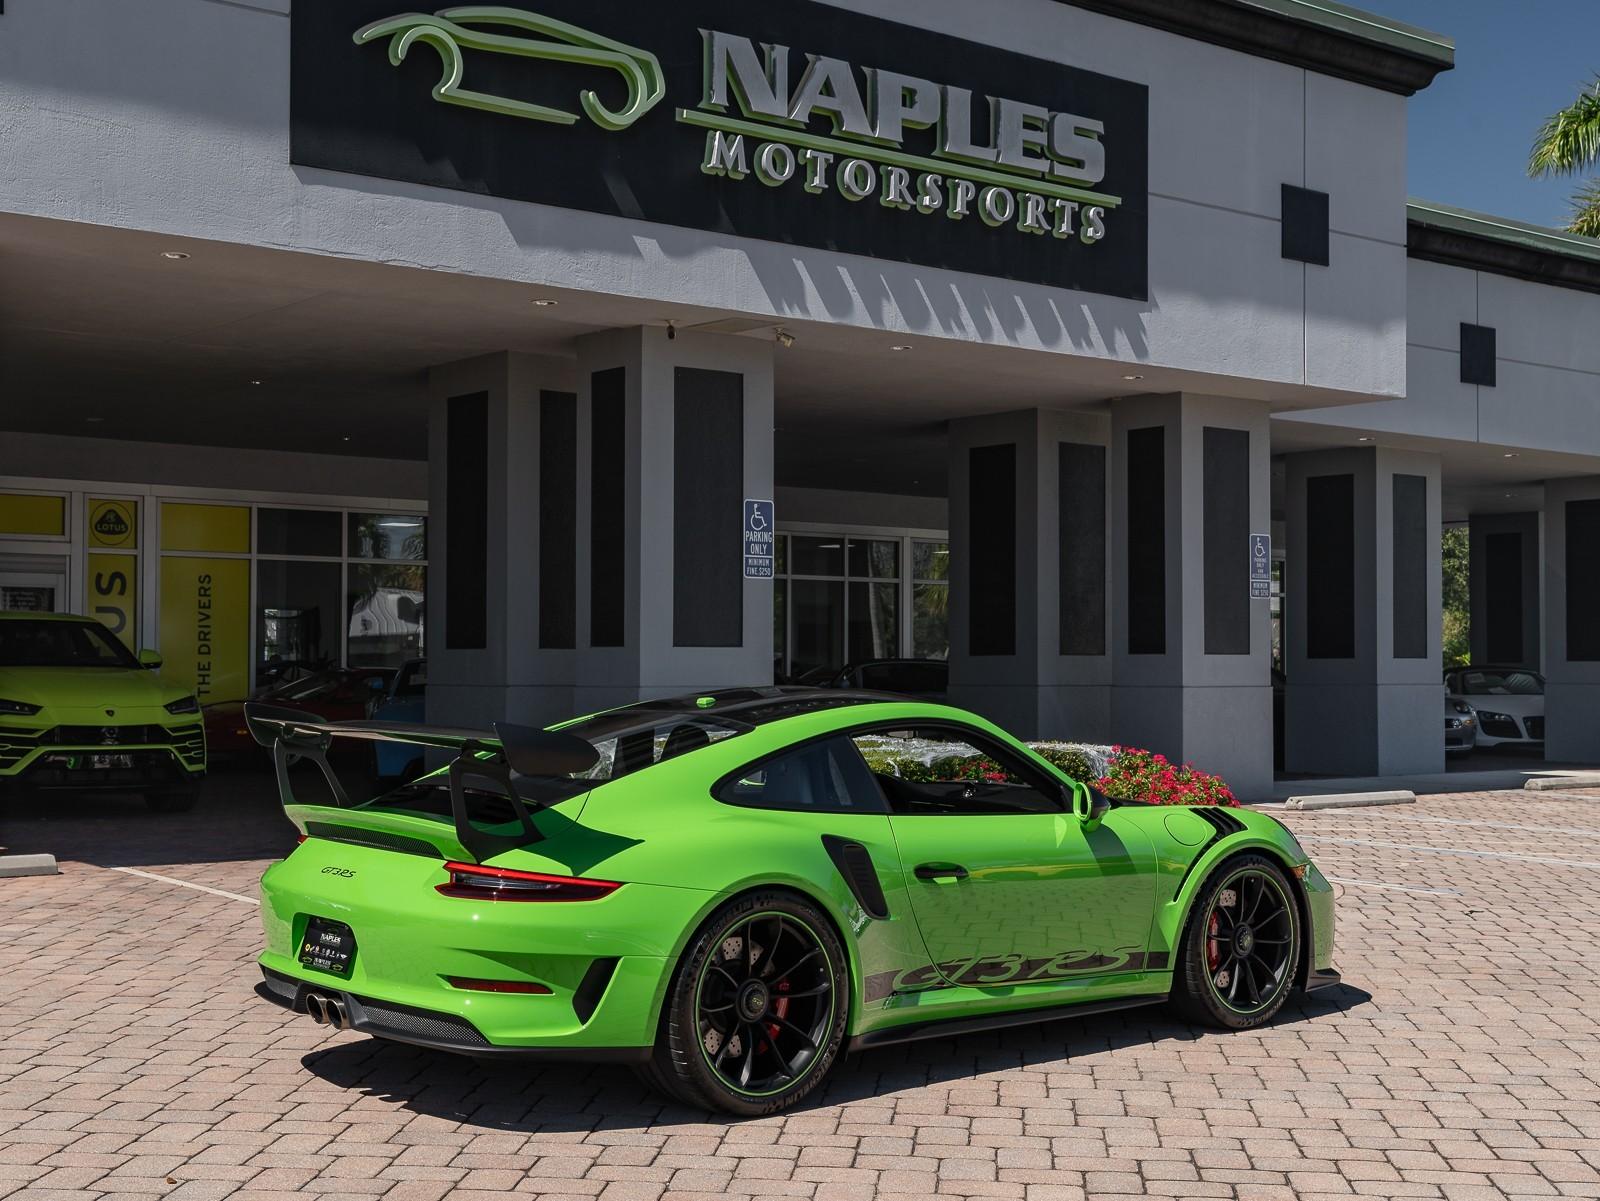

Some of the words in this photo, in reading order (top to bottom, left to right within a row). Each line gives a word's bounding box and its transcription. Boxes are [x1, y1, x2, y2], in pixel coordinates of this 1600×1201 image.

[698, 27, 1106, 187] NAPLES
[701, 131, 1106, 244] MOTORSPORTS
[97, 523, 128, 532] LOTUS
[745, 531, 773, 543] PARKING
[750, 543, 768, 555] ONLY
[748, 558, 770, 567] MINIMUM
[746, 567, 758, 575] FINE
[758, 567, 771, 576] $250
[197, 574, 212, 656] DRIVERS
[197, 661, 211, 697] THE
[320, 933, 341, 943] NAPLES
